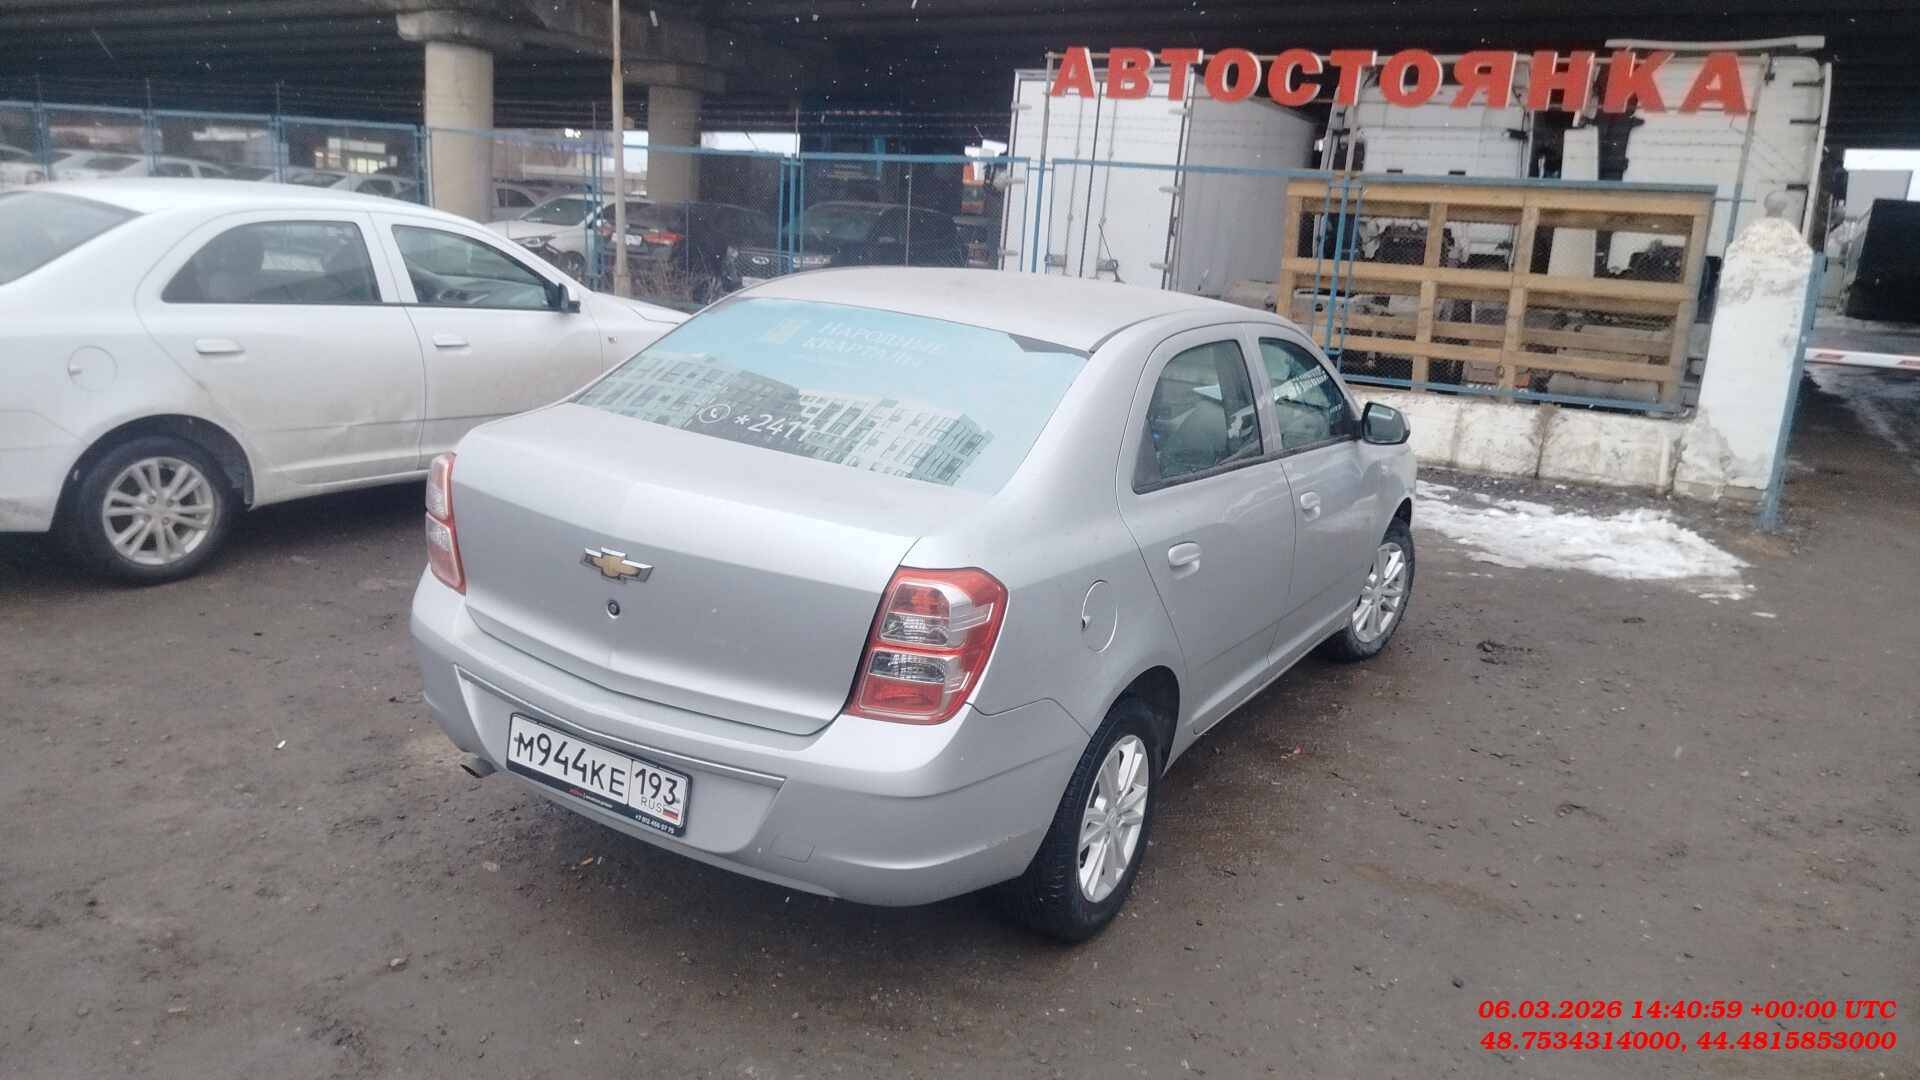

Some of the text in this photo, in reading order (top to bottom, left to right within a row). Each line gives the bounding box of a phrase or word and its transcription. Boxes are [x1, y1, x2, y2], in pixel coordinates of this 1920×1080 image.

[1050, 46, 1749, 116] АВТОСТОЯНКА
[635, 768, 678, 805] 193
[640, 796, 663, 814] RUS
